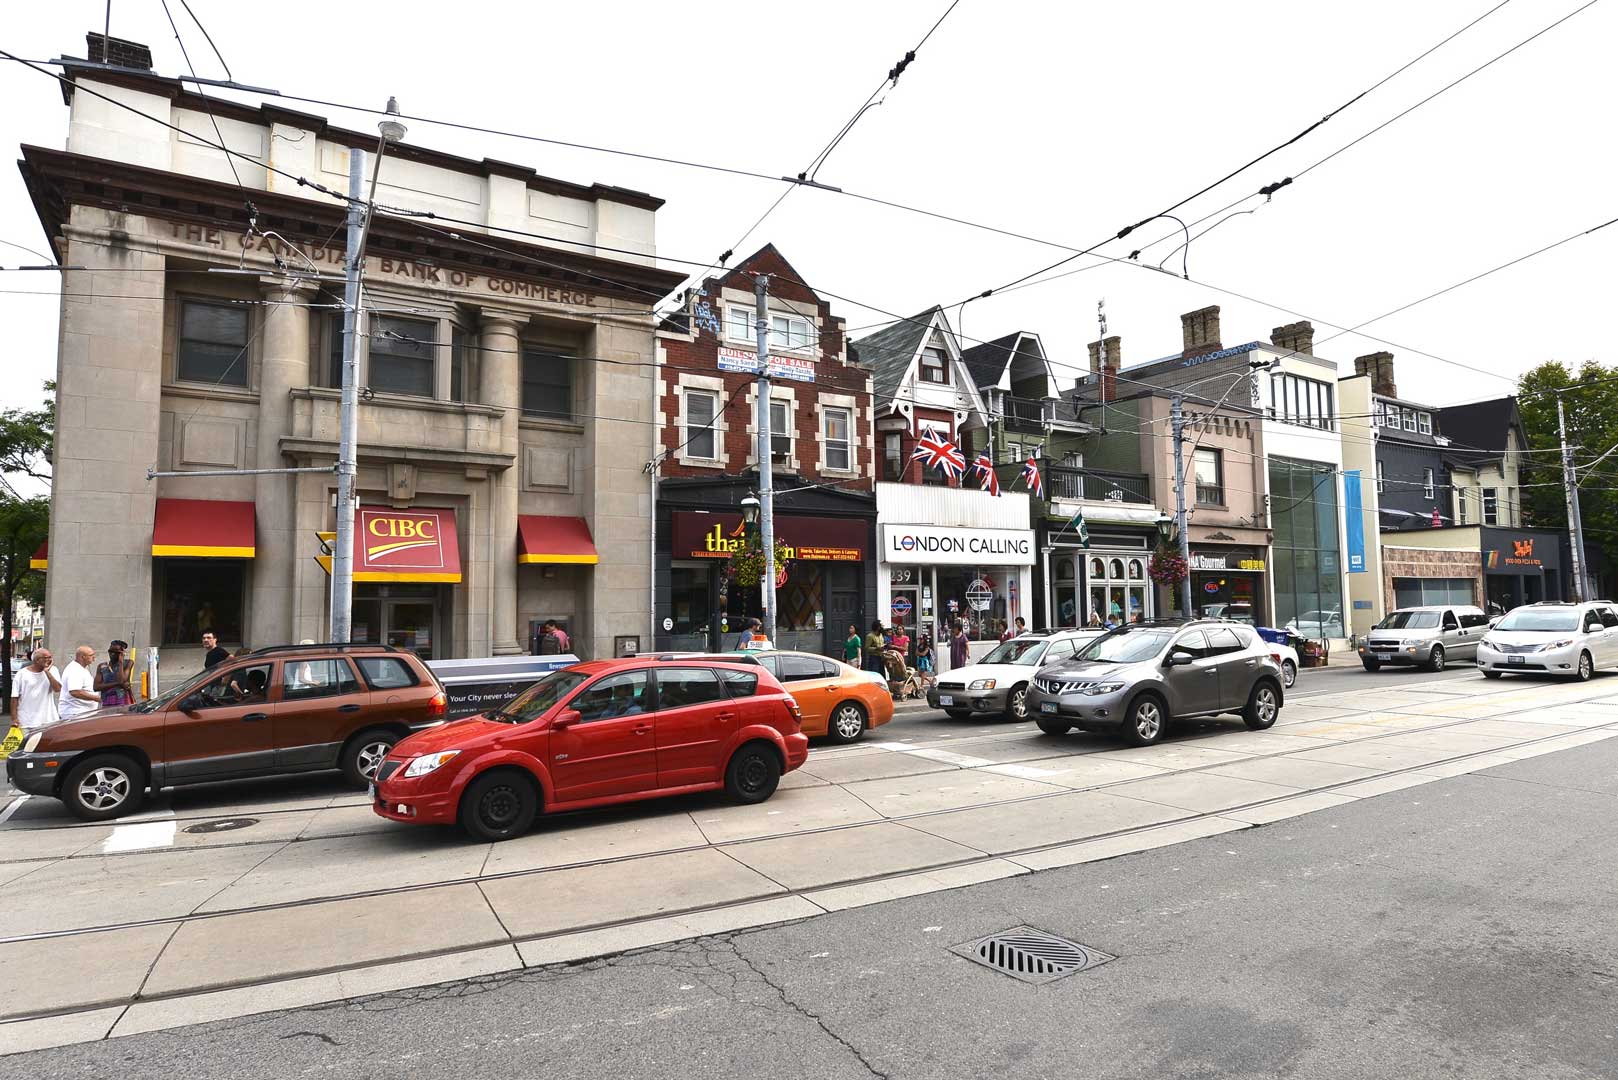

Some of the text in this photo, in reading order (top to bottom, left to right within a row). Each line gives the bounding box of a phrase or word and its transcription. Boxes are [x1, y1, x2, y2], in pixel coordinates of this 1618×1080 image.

[168, 222, 597, 307] THE CANADIA BANK OF COMMERCE
[769, 356, 787, 365] FOR
[790, 360, 813, 368] SALE
[369, 518, 434, 538] CIBC
[705, 523, 745, 552] thai
[893, 535, 1029, 554] LONDON CALLING
[1200, 555, 1226, 569] Gourmet
[468, 694, 481, 702] City
